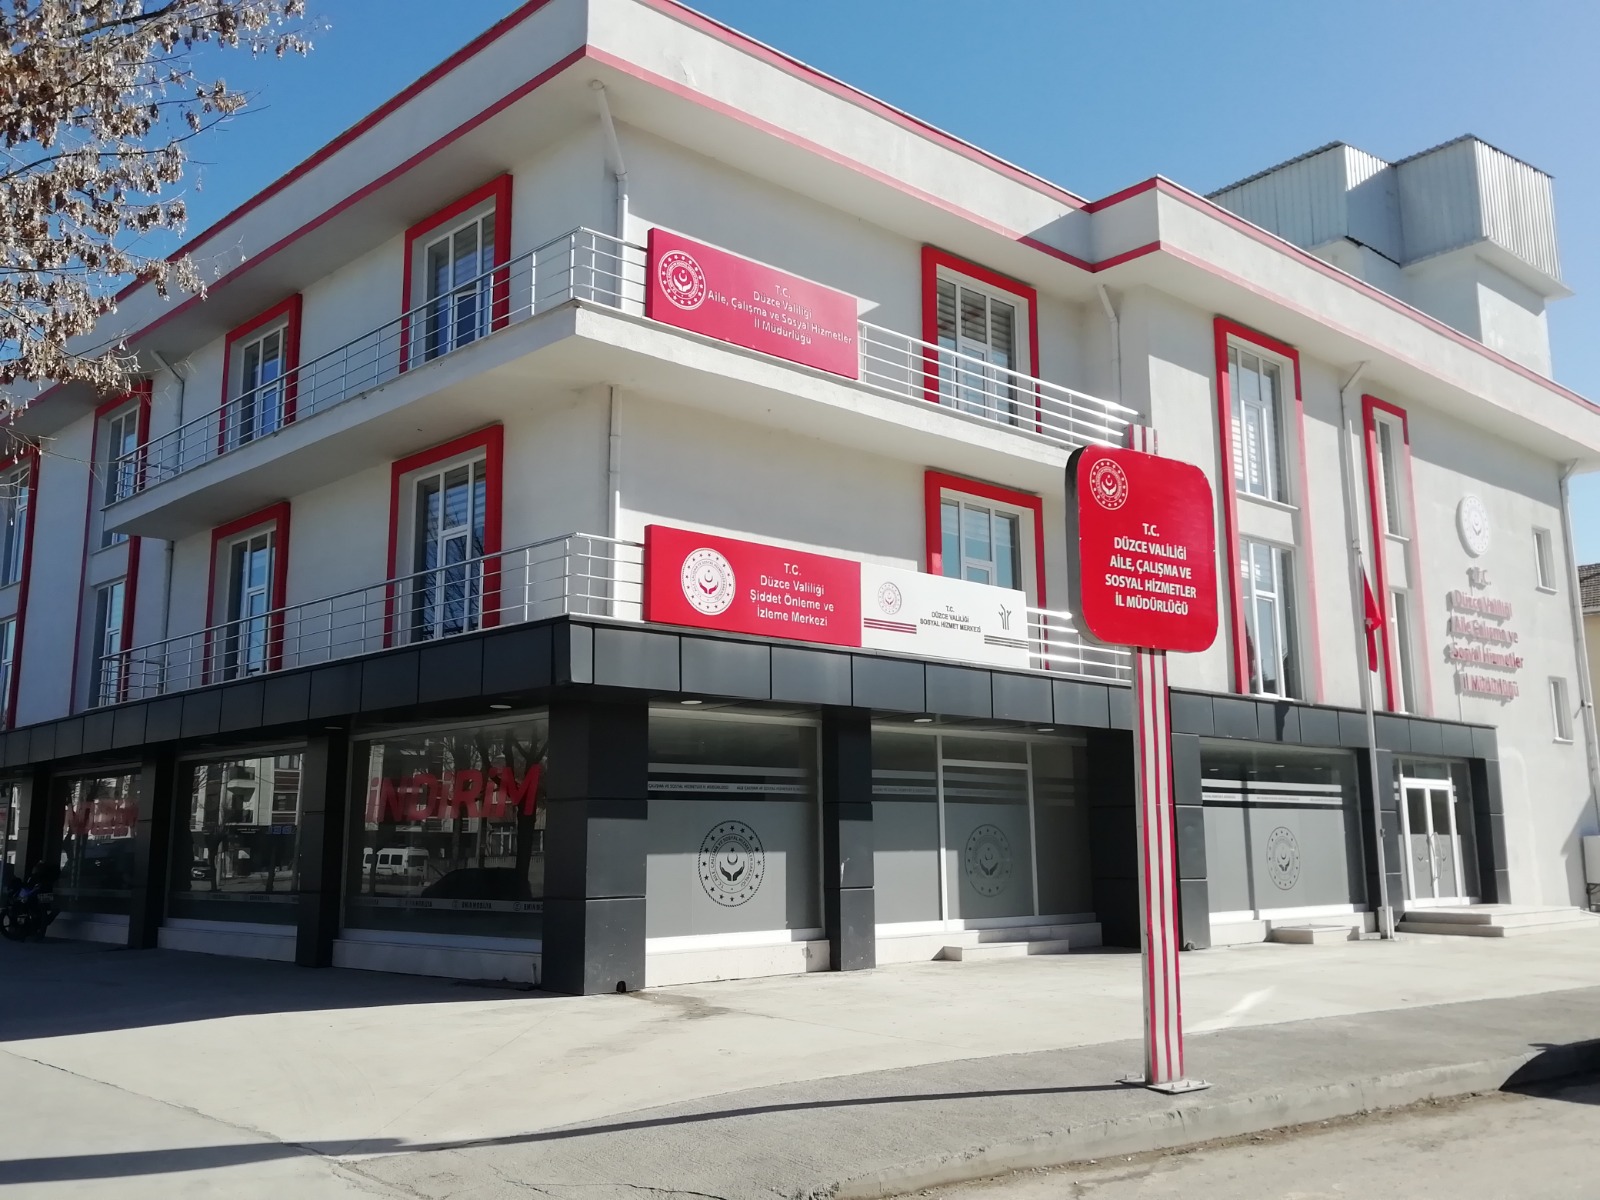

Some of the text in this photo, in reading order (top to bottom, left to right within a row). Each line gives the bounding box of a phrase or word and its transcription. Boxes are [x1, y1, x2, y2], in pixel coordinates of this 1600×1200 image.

[775, 284, 791, 299] T.C.
[707, 289, 852, 345] Aile, Çalışma ve Sosyal Hizmetler
[753, 291, 812, 320] Düzce Valiliği
[762, 320, 812, 345] Müdürlüğü
[1142, 523, 1160, 537] T.C.
[1114, 536, 1187, 561] DÜZCE VALİLİĞİ
[783, 562, 802, 576] T.C.
[1110, 553, 1192, 580] AİLE, ÇALIŞMA VE
[760, 574, 825, 597] Düzce Valiliği
[1105, 574, 1197, 599] SOSYAL HİZMETLER
[749, 588, 834, 612] Şiddet Önleme ve
[1115, 591, 1189, 616] İL MÜDÜRLÜĞÜ
[757, 604, 828, 627] İzleme Merkezi
[920, 618, 940, 626] SOSYAL
[931, 611, 949, 621] DÜZCE
